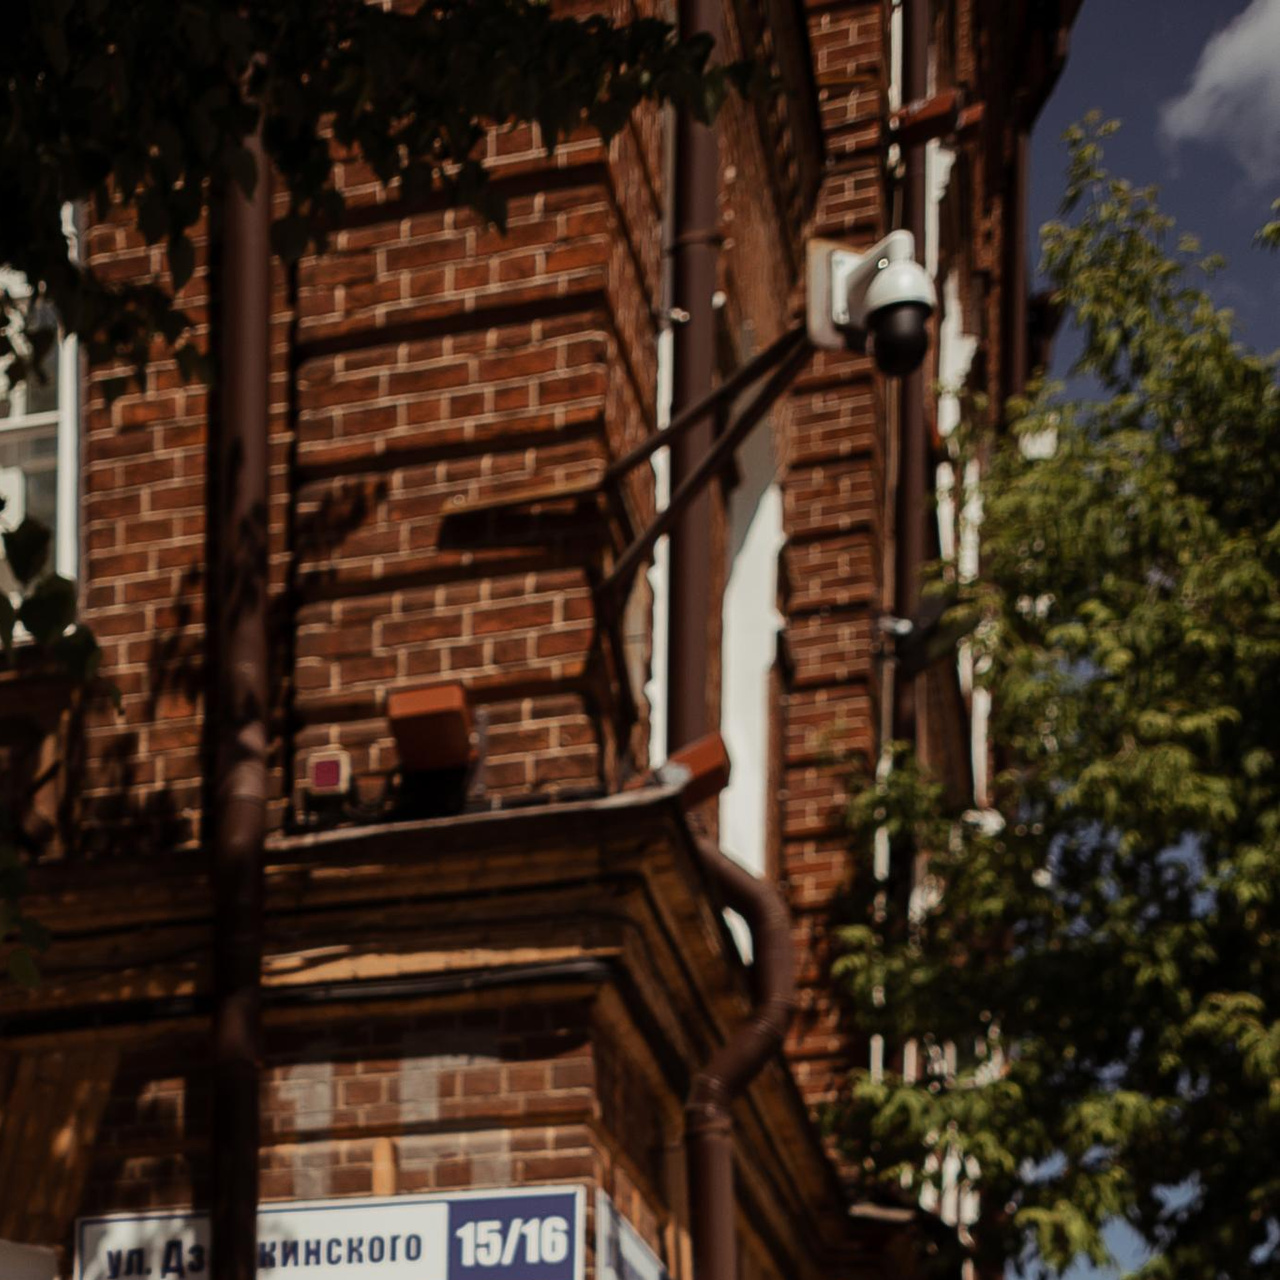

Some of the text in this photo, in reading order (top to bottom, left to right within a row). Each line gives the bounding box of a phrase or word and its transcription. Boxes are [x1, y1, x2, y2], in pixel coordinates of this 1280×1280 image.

[106, 1233, 422, 1280] ул. Дзжинского
[455, 1216, 569, 1267] 15/16
